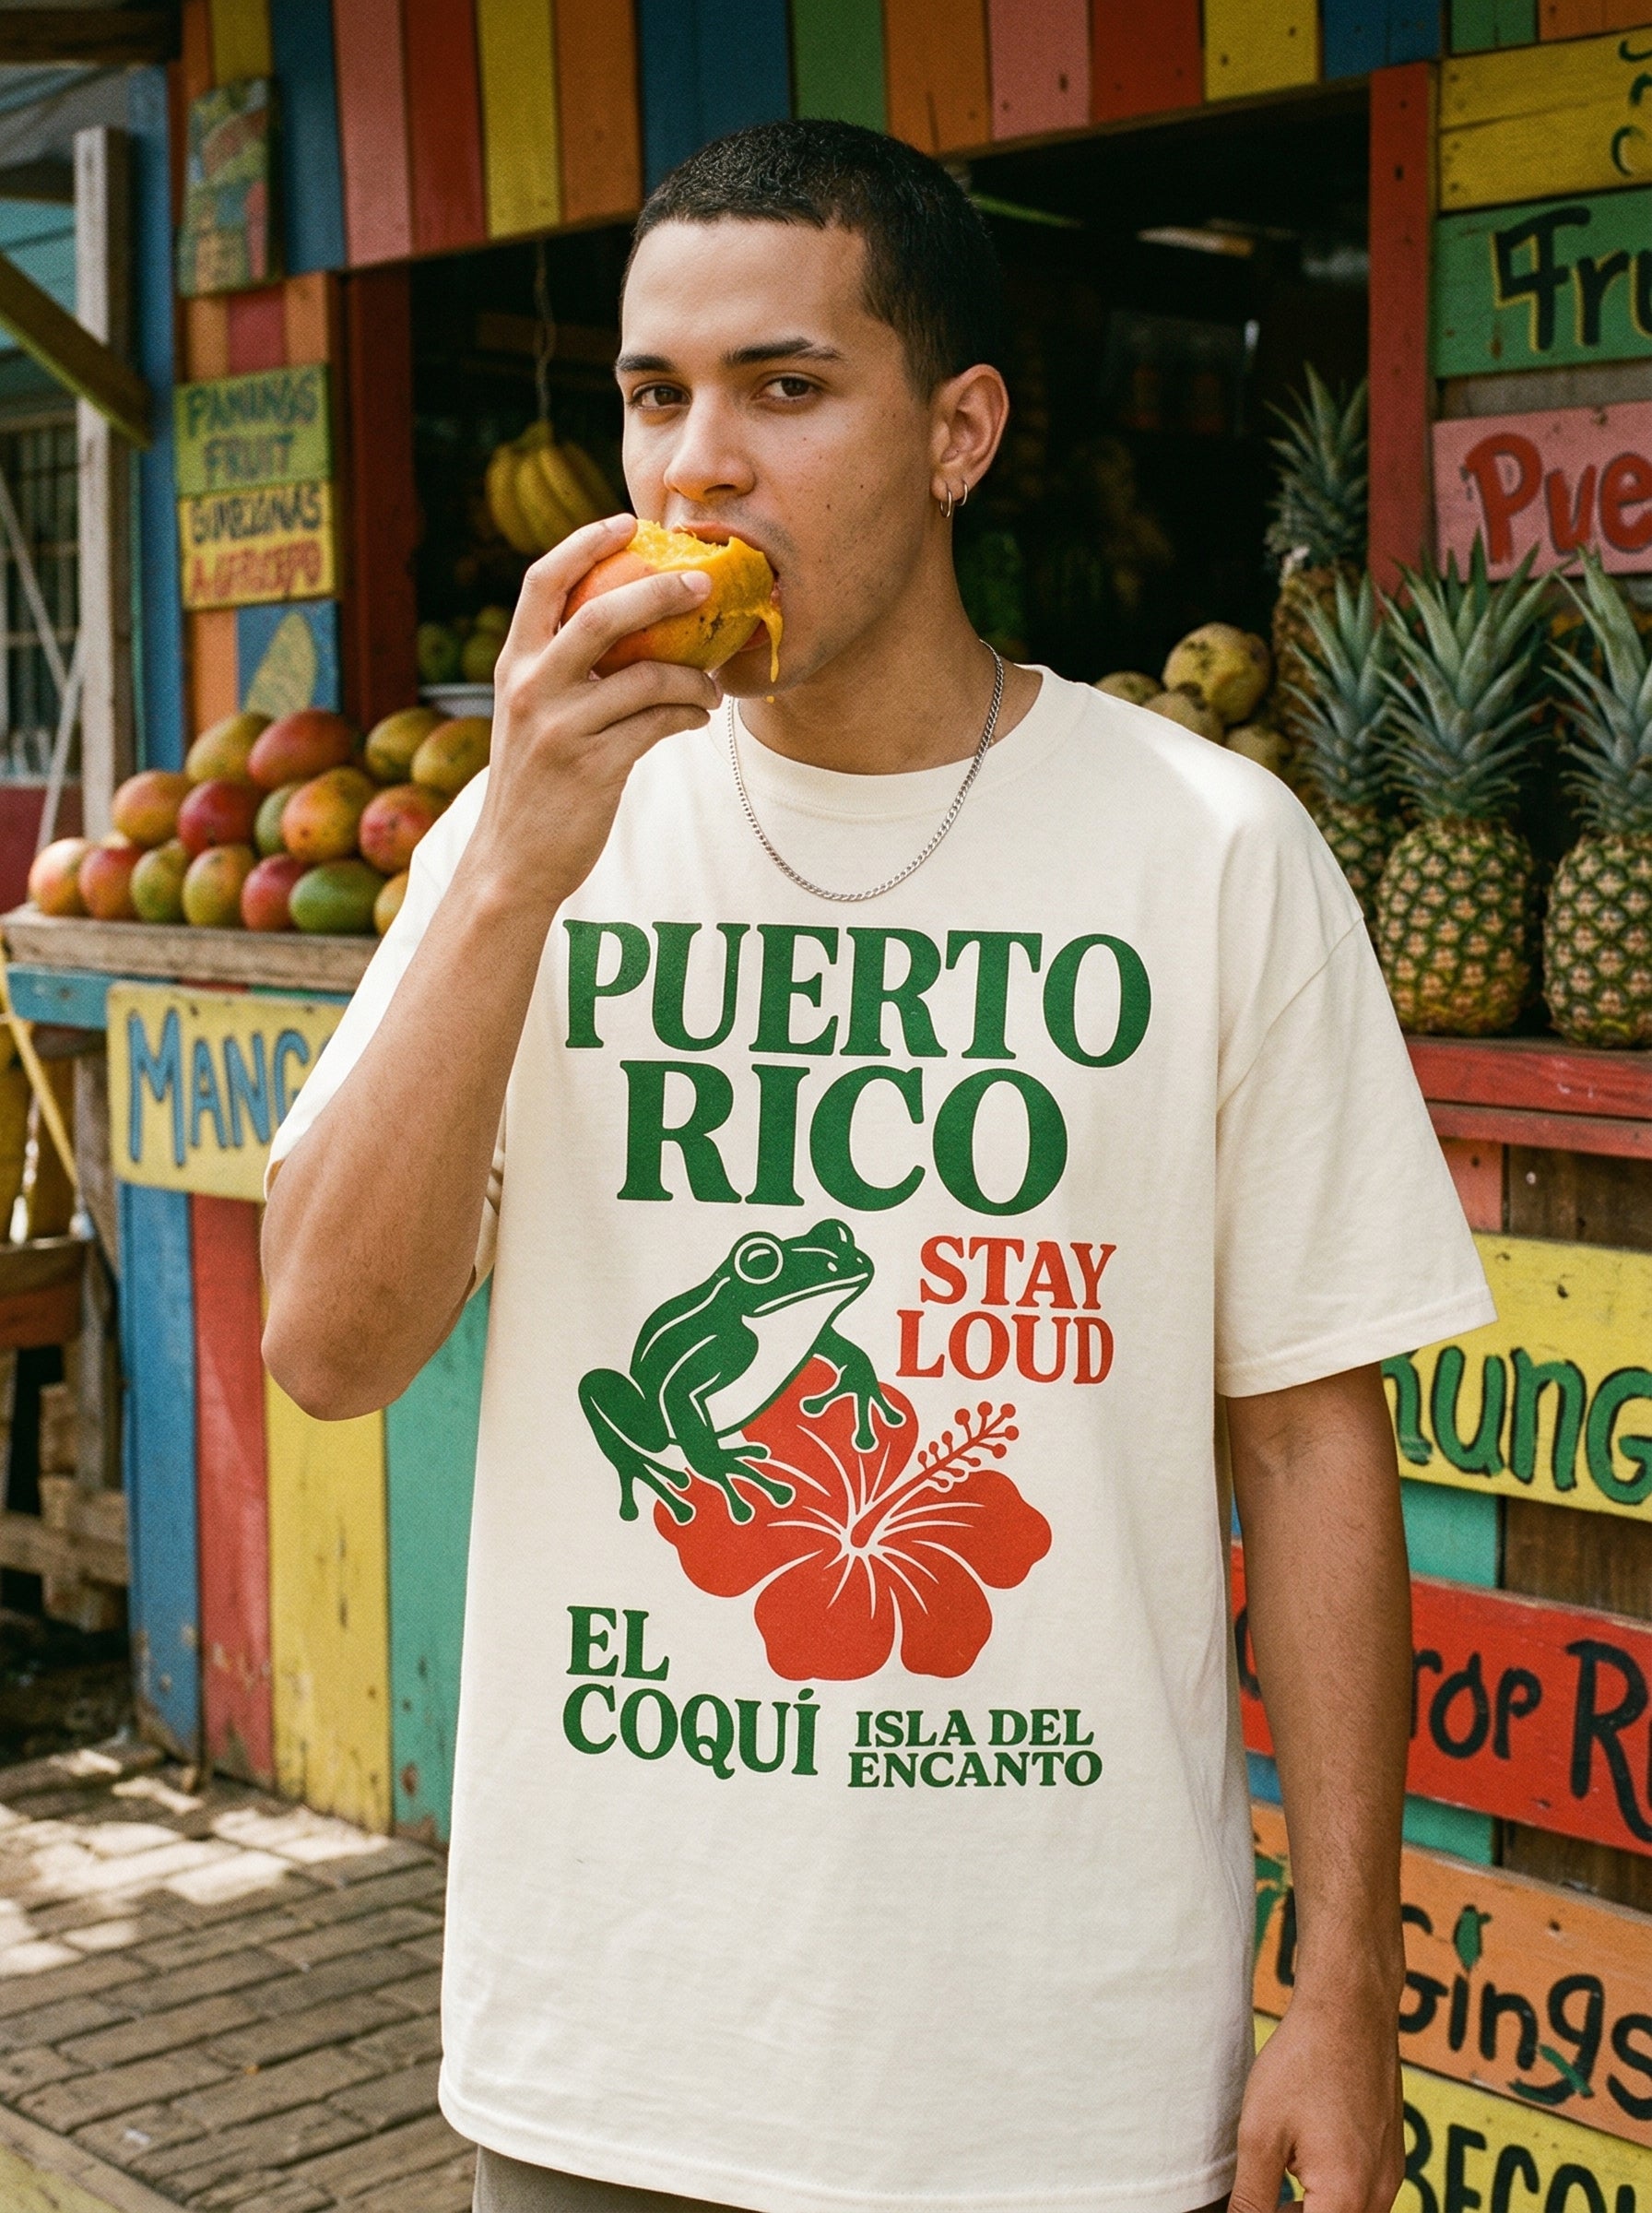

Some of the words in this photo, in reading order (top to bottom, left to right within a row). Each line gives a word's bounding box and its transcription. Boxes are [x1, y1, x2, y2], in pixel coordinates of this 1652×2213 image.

[204, 432, 295, 491] FRUIT
[562, 918, 1152, 1069] PUERTO
[127, 1006, 329, 1167] MANG
[617, 1059, 1068, 1217] RICO
[919, 1236, 1117, 1310] STAY
[896, 1309, 1115, 1385] LOUD
[565, 1605, 670, 1681] EL
[562, 1684, 821, 1780] COQUÍ
[855, 1710, 977, 1747] ISLA
[988, 1709, 1095, 1747] DEL
[847, 1751, 1103, 1788] ENCANTO
